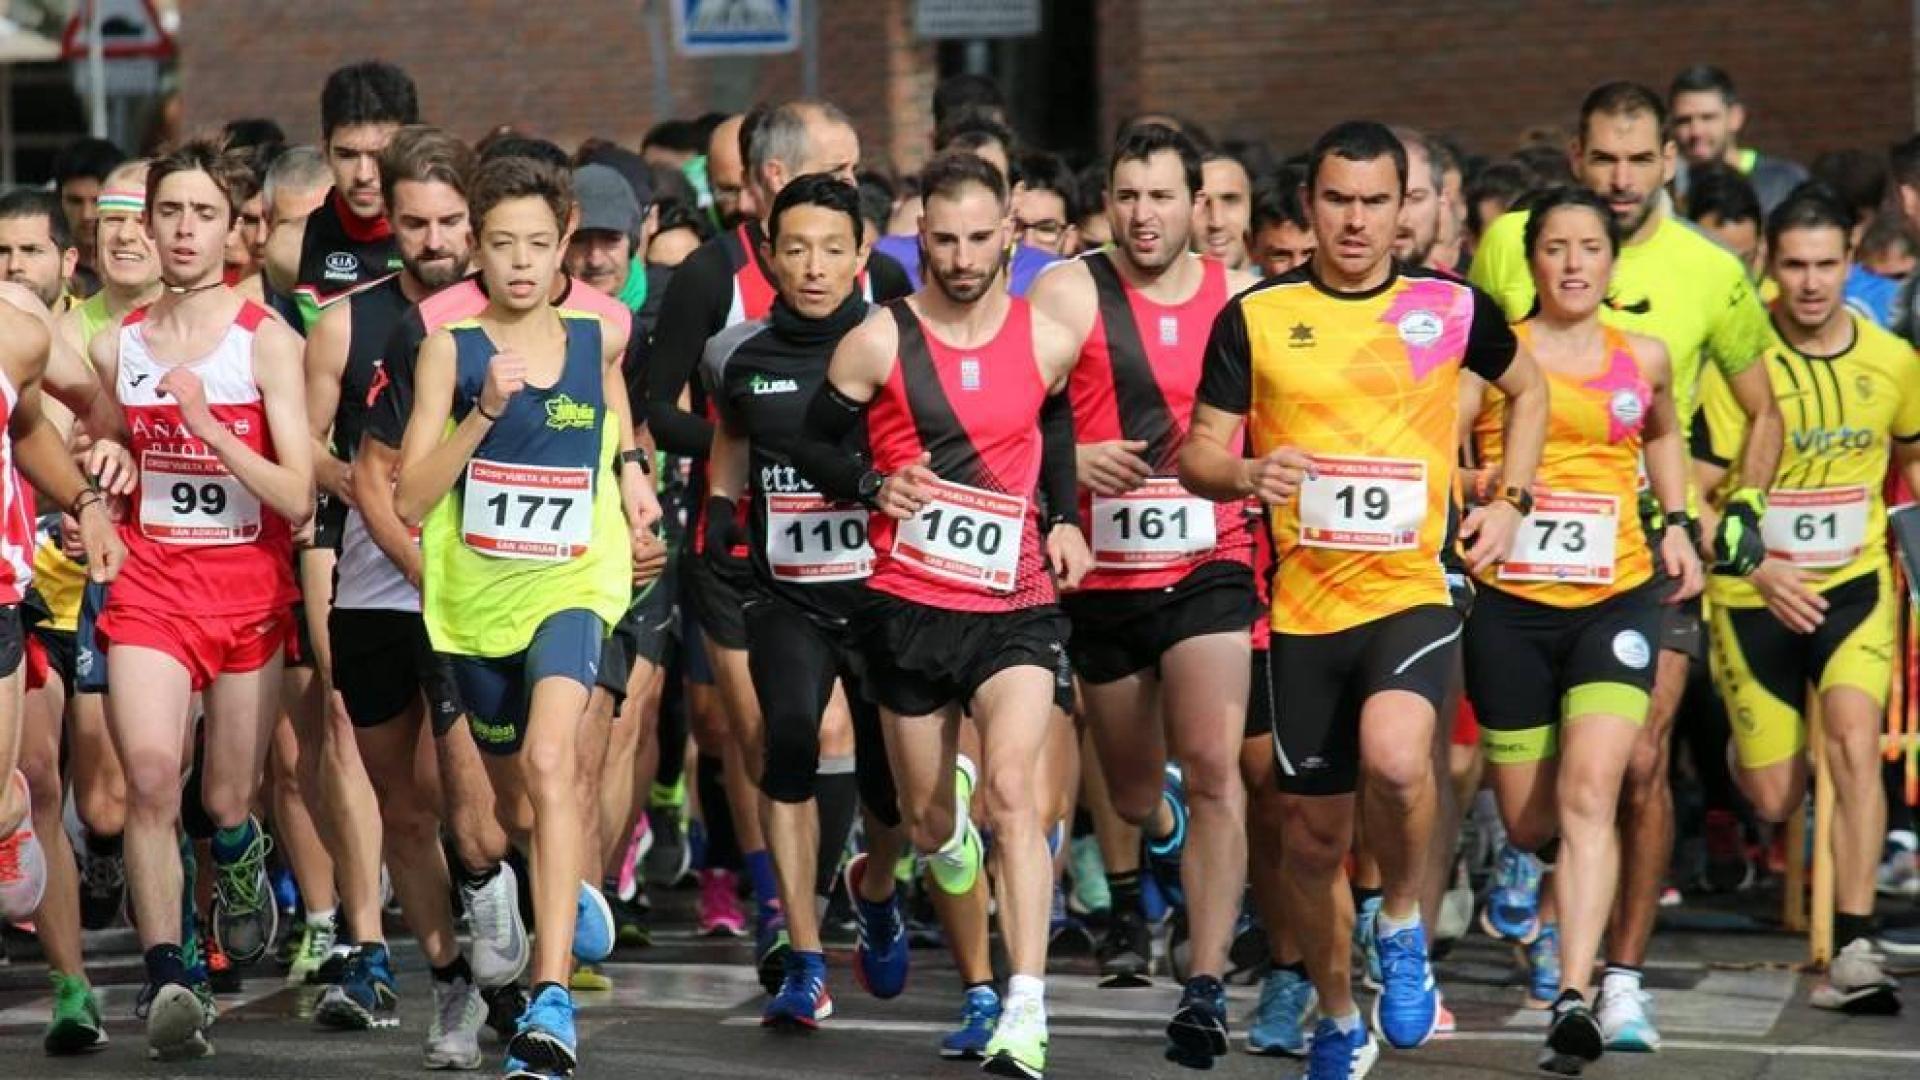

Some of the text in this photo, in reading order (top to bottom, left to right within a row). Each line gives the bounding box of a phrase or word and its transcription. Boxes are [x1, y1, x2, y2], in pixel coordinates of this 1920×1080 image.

[170, 482, 227, 515] 99
[487, 492, 574, 530] 177
[1335, 484, 1390, 520] 19
[785, 518, 864, 553] 110
[922, 509, 1002, 556] 160
[1112, 506, 1188, 540] 161
[1534, 519, 1587, 552] 73
[1794, 512, 1836, 542] 61
[496, 541, 515, 551] SAN
